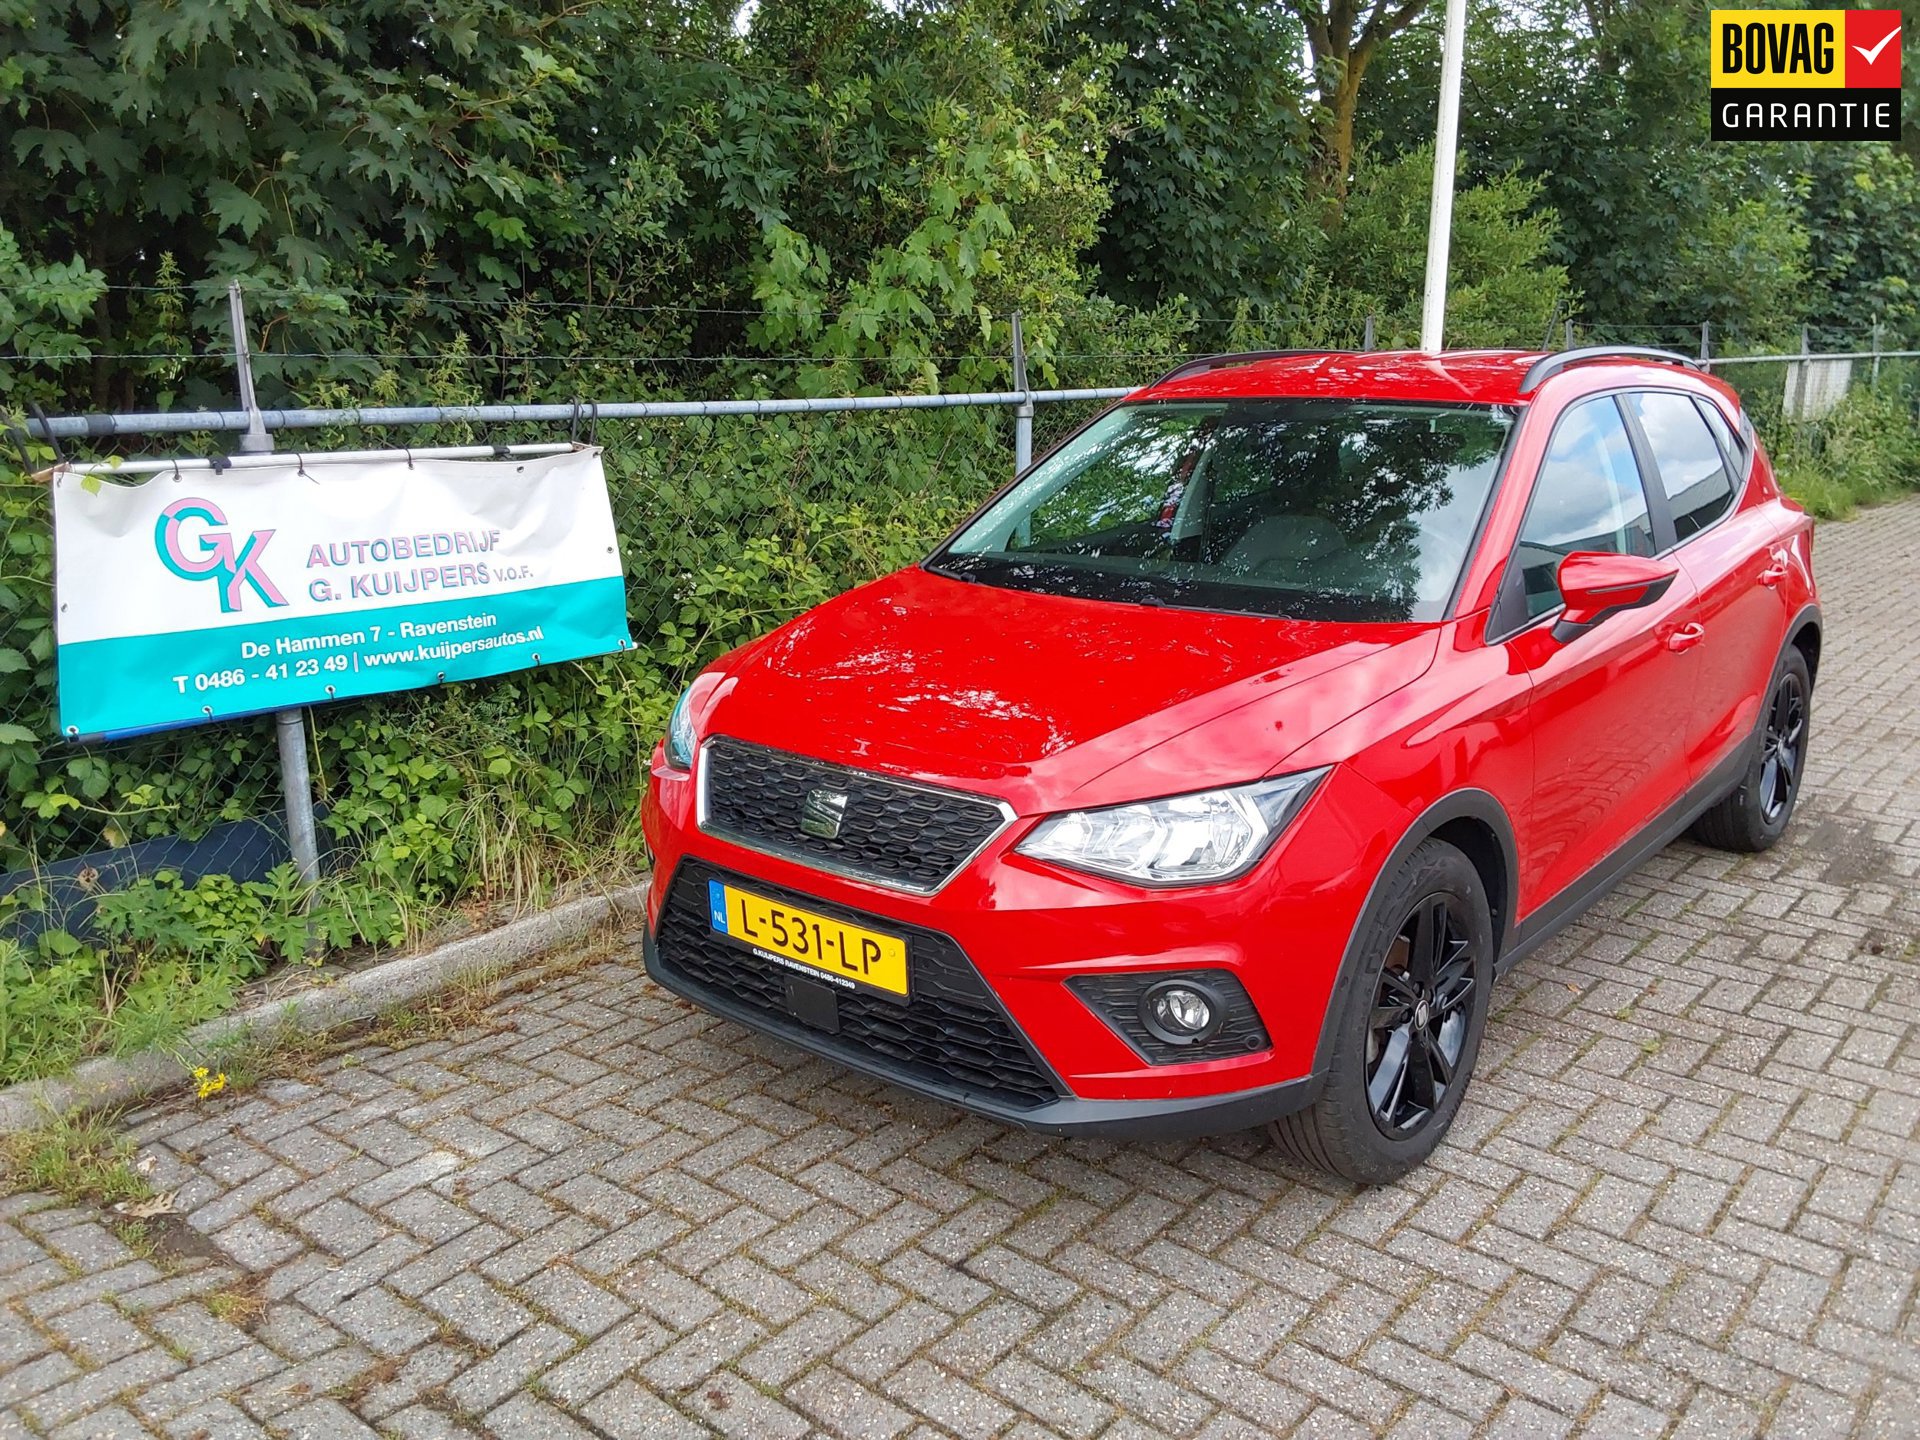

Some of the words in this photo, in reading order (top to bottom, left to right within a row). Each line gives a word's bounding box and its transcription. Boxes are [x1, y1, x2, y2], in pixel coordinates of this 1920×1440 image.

[155, 497, 290, 613] GK
[306, 529, 500, 568] AUTOBEDRIJF
[309, 577, 342, 602] G.
[350, 562, 490, 598] KUIJPERS
[494, 565, 534, 582] V.O.F.
[241, 641, 271, 659] De
[275, 631, 365, 655] Hammen
[370, 626, 381, 642] 7
[400, 612, 497, 639] Ravenstein
[172, 675, 189, 694] T
[194, 668, 246, 691] 0486
[265, 663, 288, 680] 41
[295, 658, 320, 677] 23
[323, 654, 348, 671] 49
[364, 626, 545, 667] www.kuijpersautos.nl
[713, 910, 726, 924] NL
[741, 899, 882, 975] L-531-LP
[784, 959, 820, 978] RAVENSTEIN
